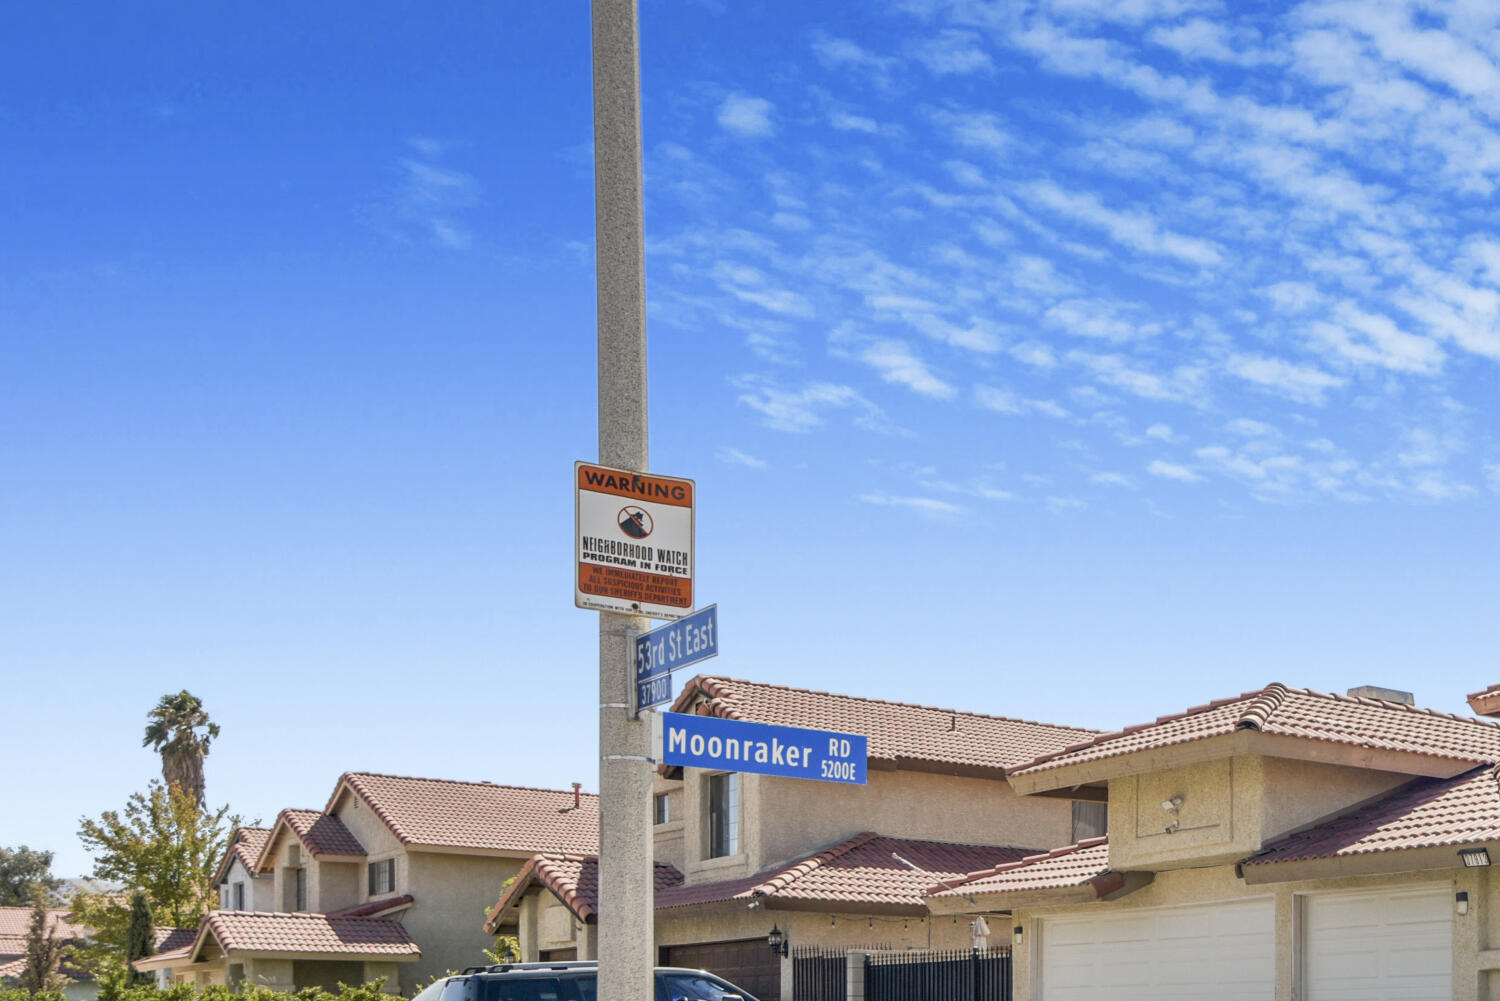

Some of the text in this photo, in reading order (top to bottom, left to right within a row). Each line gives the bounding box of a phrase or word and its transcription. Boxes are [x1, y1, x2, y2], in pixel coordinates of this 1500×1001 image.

[585, 471, 686, 501] WARNING
[583, 535, 688, 566] NEIGHBORHOOD WATCH
[583, 551, 688, 575] PROGRAM IN FORCE
[638, 617, 714, 674] 53rd St East
[641, 678, 667, 705] 37900
[668, 727, 813, 768] Moonraker
[828, 738, 851, 758] RD
[821, 759, 856, 781] 5200E
